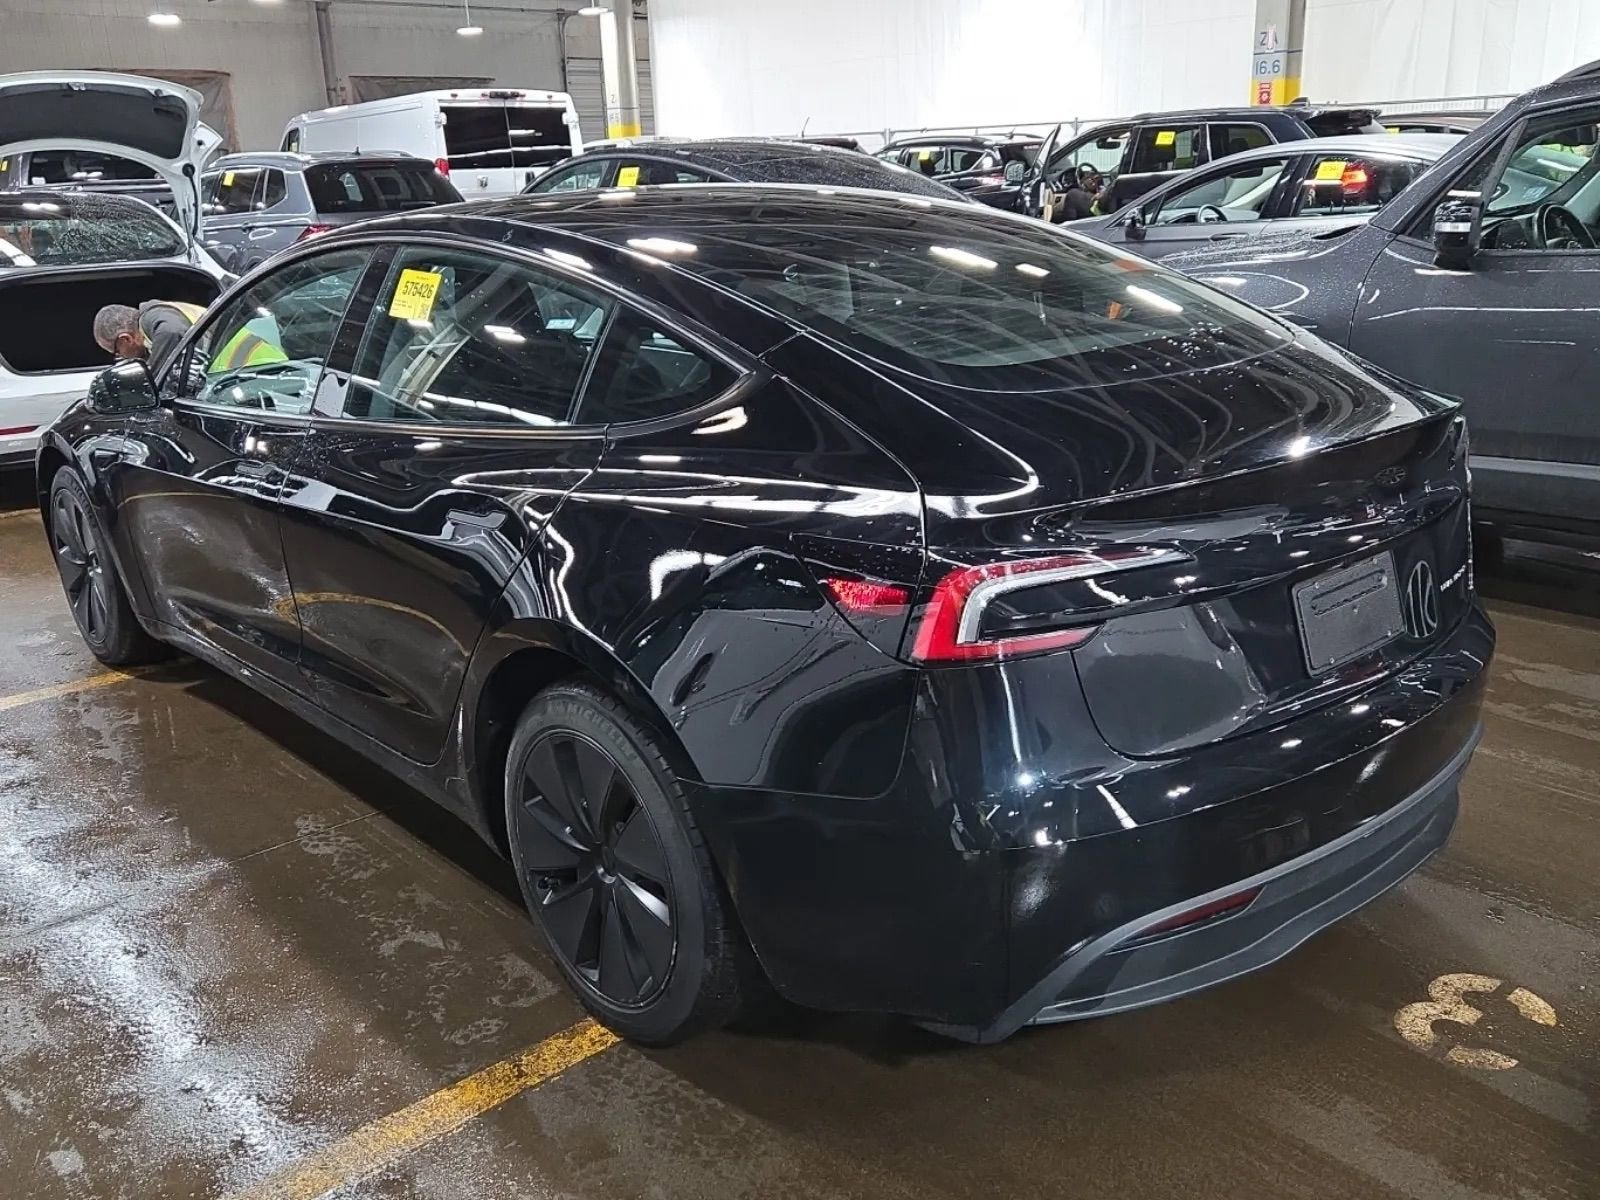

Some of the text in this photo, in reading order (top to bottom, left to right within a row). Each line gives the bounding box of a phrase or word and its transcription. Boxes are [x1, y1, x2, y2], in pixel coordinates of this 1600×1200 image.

[1255, 59, 1281, 75] 16.6
[402, 281, 435, 298] 575426
[566, 703, 638, 761] MICHELIN
